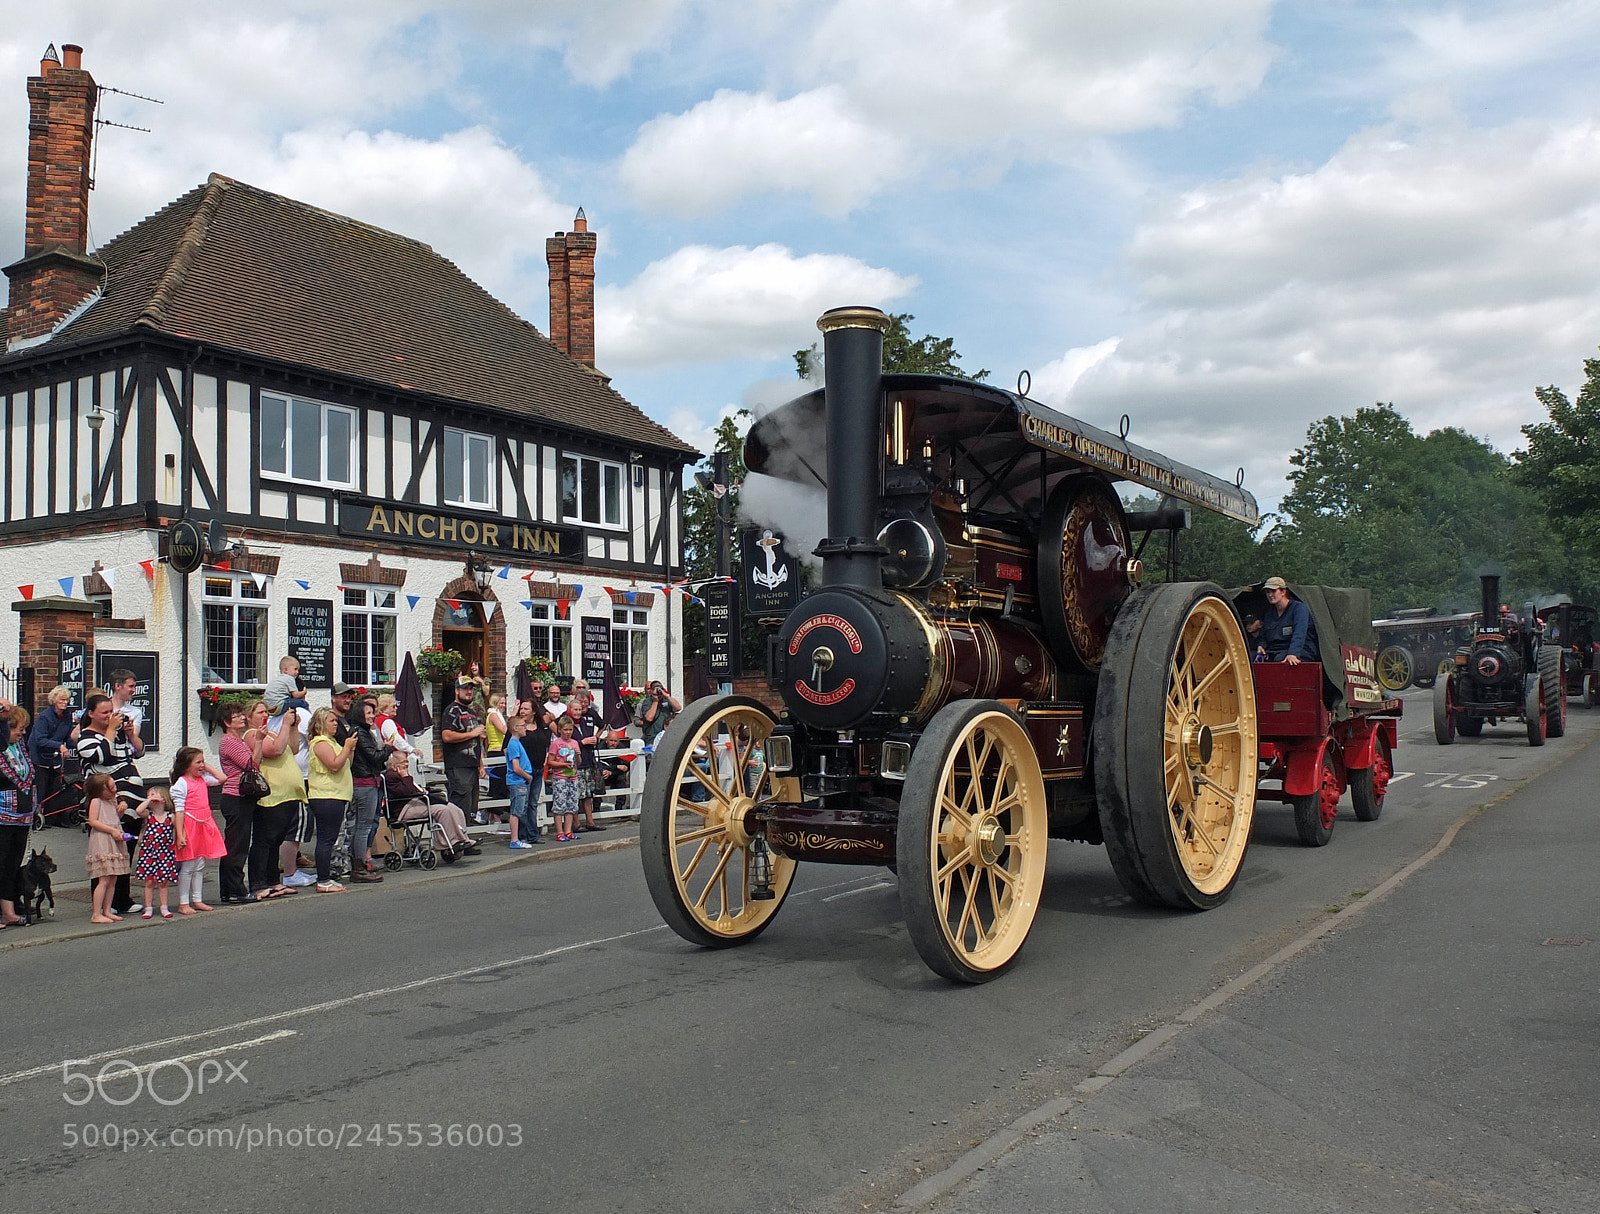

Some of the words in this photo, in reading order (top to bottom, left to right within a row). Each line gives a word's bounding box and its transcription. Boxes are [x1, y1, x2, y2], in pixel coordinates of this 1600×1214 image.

[1026, 415, 1073, 450] CHARLES
[1075, 434, 1125, 471] OPENSHAW
[366, 505, 499, 547] ANCHOR
[512, 524, 560, 554] INN
[291, 606, 315, 617] ANCHOR
[317, 607, 328, 617] INN
[710, 608, 728, 616] FOOD
[295, 617, 314, 628] UNDER
[800, 618, 822, 637] FOWLER
[62, 655, 82, 673] BEER
[712, 653, 728, 662] LIVE
[832, 683, 852, 701] LEEDS
